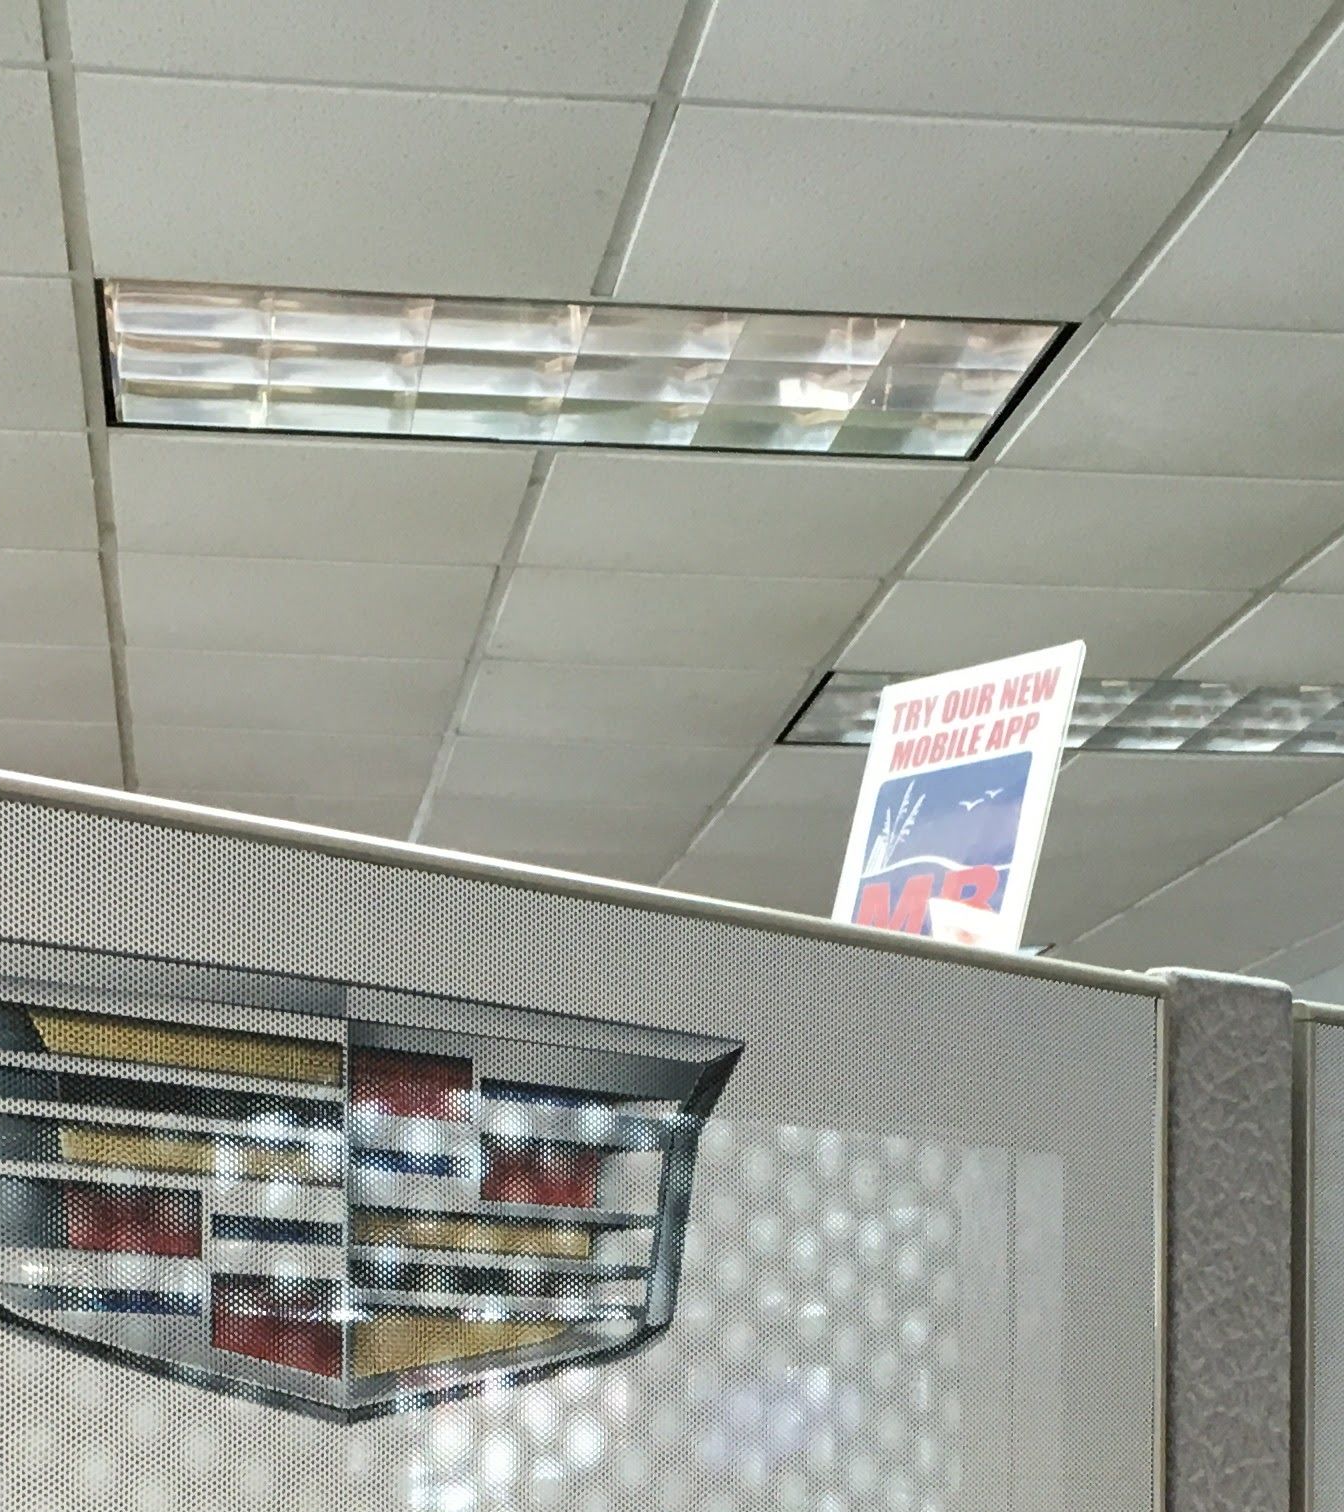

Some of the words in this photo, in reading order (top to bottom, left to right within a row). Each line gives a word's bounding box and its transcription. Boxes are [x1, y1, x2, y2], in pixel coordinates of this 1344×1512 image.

[892, 696, 938, 734] TRY
[942, 683, 995, 724] OUR
[1000, 667, 1061, 711] NEW
[889, 724, 984, 772] MOBILE
[985, 712, 1040, 752] APP
